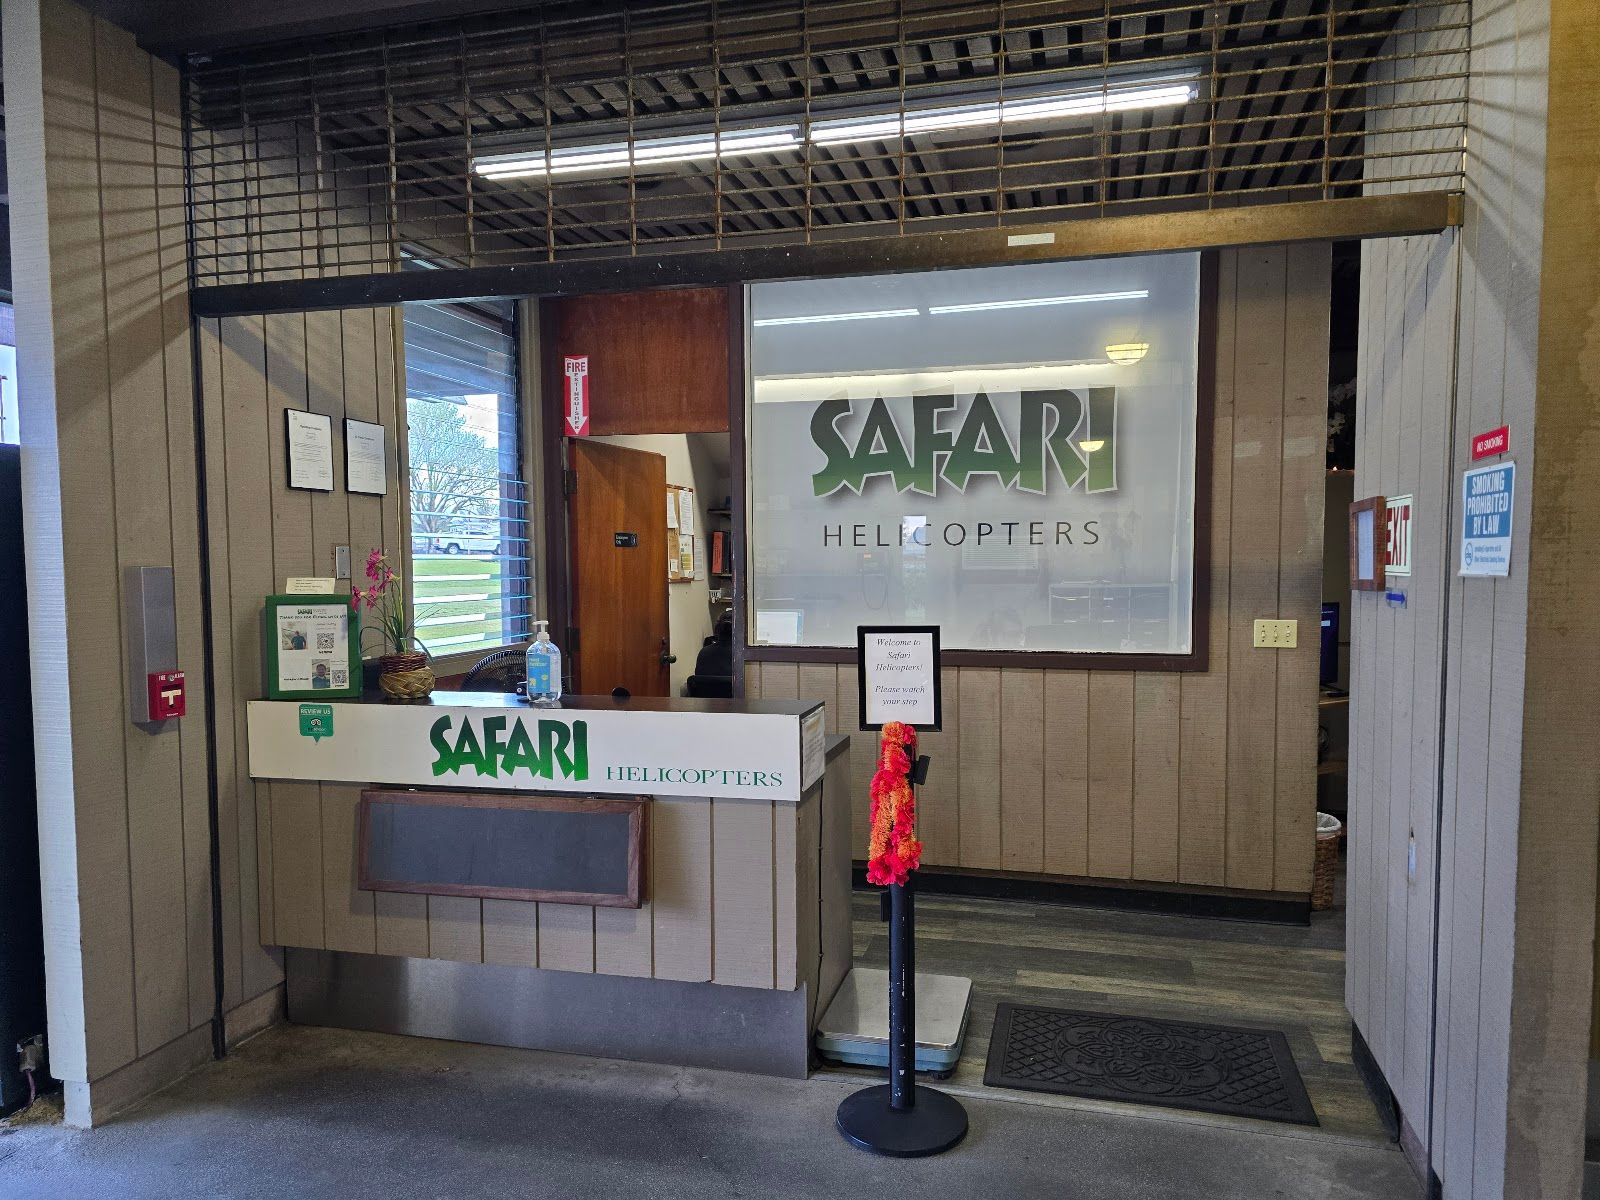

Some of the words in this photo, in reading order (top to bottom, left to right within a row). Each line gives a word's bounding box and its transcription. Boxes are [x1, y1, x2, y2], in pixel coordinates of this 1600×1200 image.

[566, 361, 586, 373] FIRE
[810, 384, 1118, 498] SAFARI
[1476, 441, 1484, 453] NO
[1484, 434, 1504, 451] SMOKING
[1472, 471, 1505, 495] SMOKING
[1467, 492, 1509, 516] PROHIBITED
[823, 520, 1100, 547] HELICOPTERS
[1473, 515, 1481, 536] BY
[1482, 514, 1500, 535] LAW
[876, 638, 912, 646] Welcome
[887, 651, 911, 660] Safari
[875, 663, 923, 672] Helicopters!
[875, 685, 901, 693] Please
[902, 685, 925, 694] watch
[882, 699, 900, 707] your
[901, 698, 918, 706] step
[429, 714, 589, 782] SAFARI
[606, 765, 783, 788] HELICOPTERS
